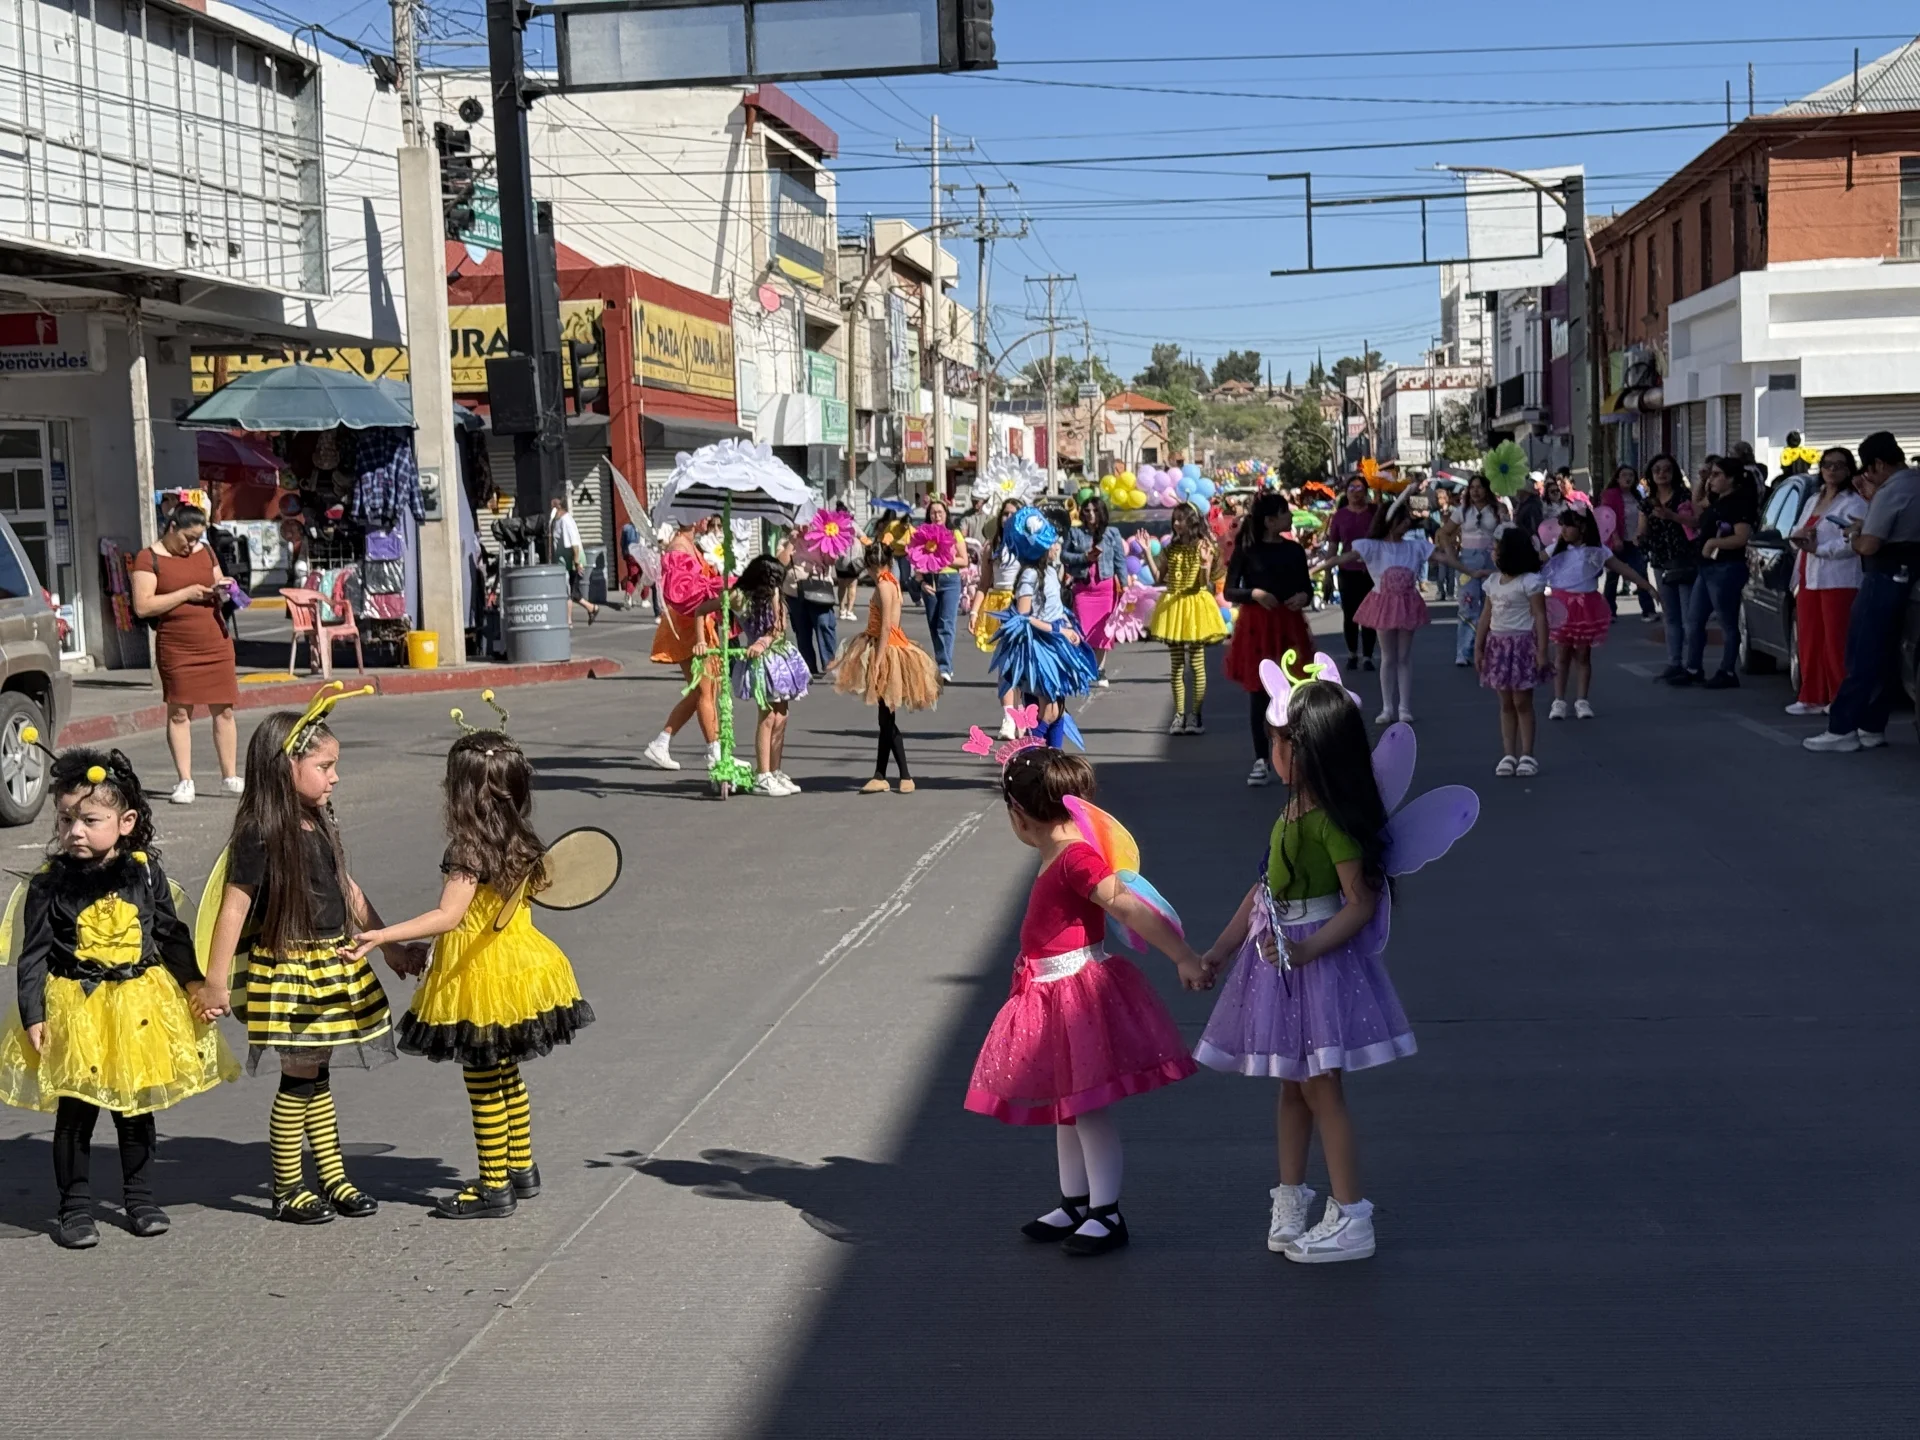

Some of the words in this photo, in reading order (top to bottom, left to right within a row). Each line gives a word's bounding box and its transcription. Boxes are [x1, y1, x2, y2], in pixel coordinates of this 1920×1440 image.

[657, 324, 680, 359] PATA
[693, 335, 716, 366] DURA
[507, 603, 549, 614] SERVICIOS
